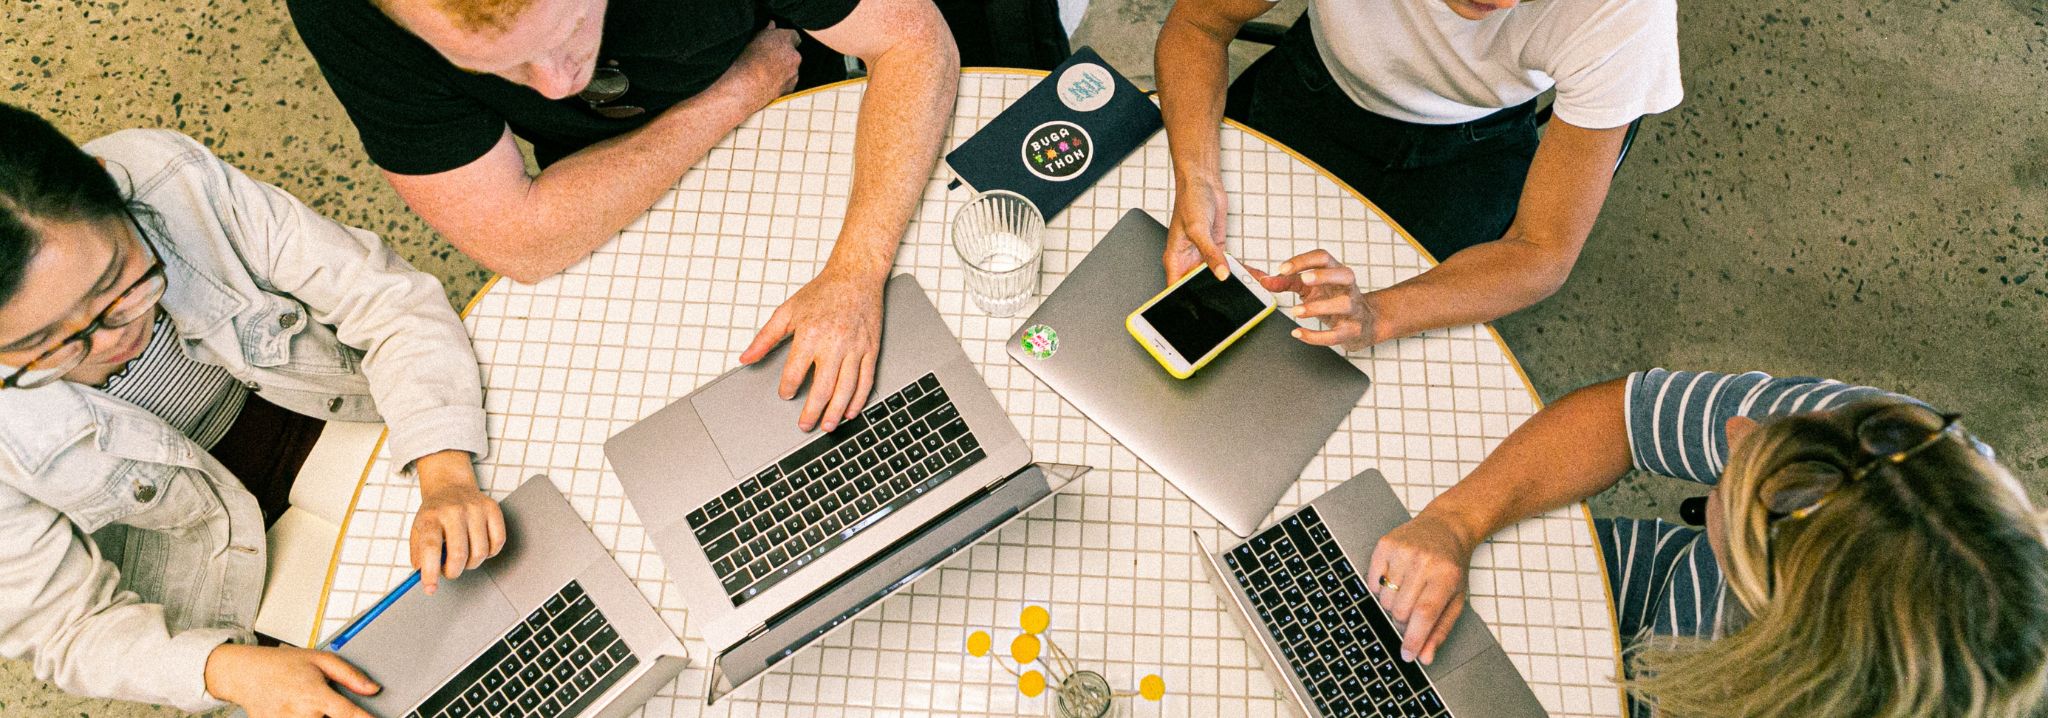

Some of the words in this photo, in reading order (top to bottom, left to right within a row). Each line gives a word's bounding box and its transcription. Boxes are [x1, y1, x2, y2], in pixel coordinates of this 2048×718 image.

[1030, 127, 1070, 151] BUGA
[1045, 149, 1085, 173] THON
[827, 500, 834, 508] U
